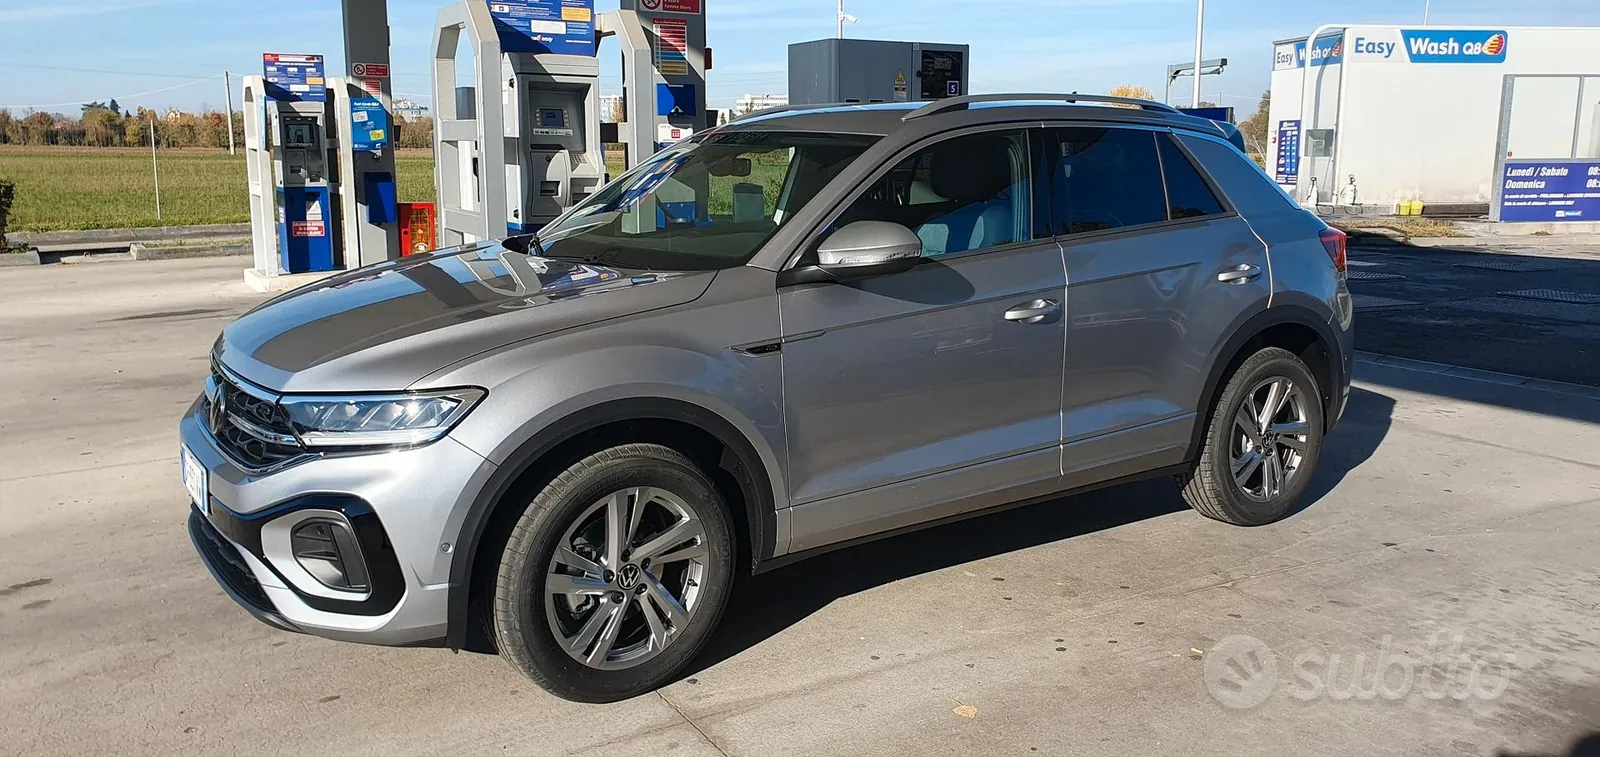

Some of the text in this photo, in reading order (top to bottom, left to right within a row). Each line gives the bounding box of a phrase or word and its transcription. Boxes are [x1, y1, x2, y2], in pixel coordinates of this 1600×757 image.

[1276, 51, 1294, 66] Easy
[1299, 45, 1321, 61] Wsh
[1354, 37, 1482, 59] Easy Wash Q8
[1506, 166, 1535, 177] Lunedì
[1540, 166, 1569, 177] Sabato
[1504, 179, 1546, 189] Domenica
